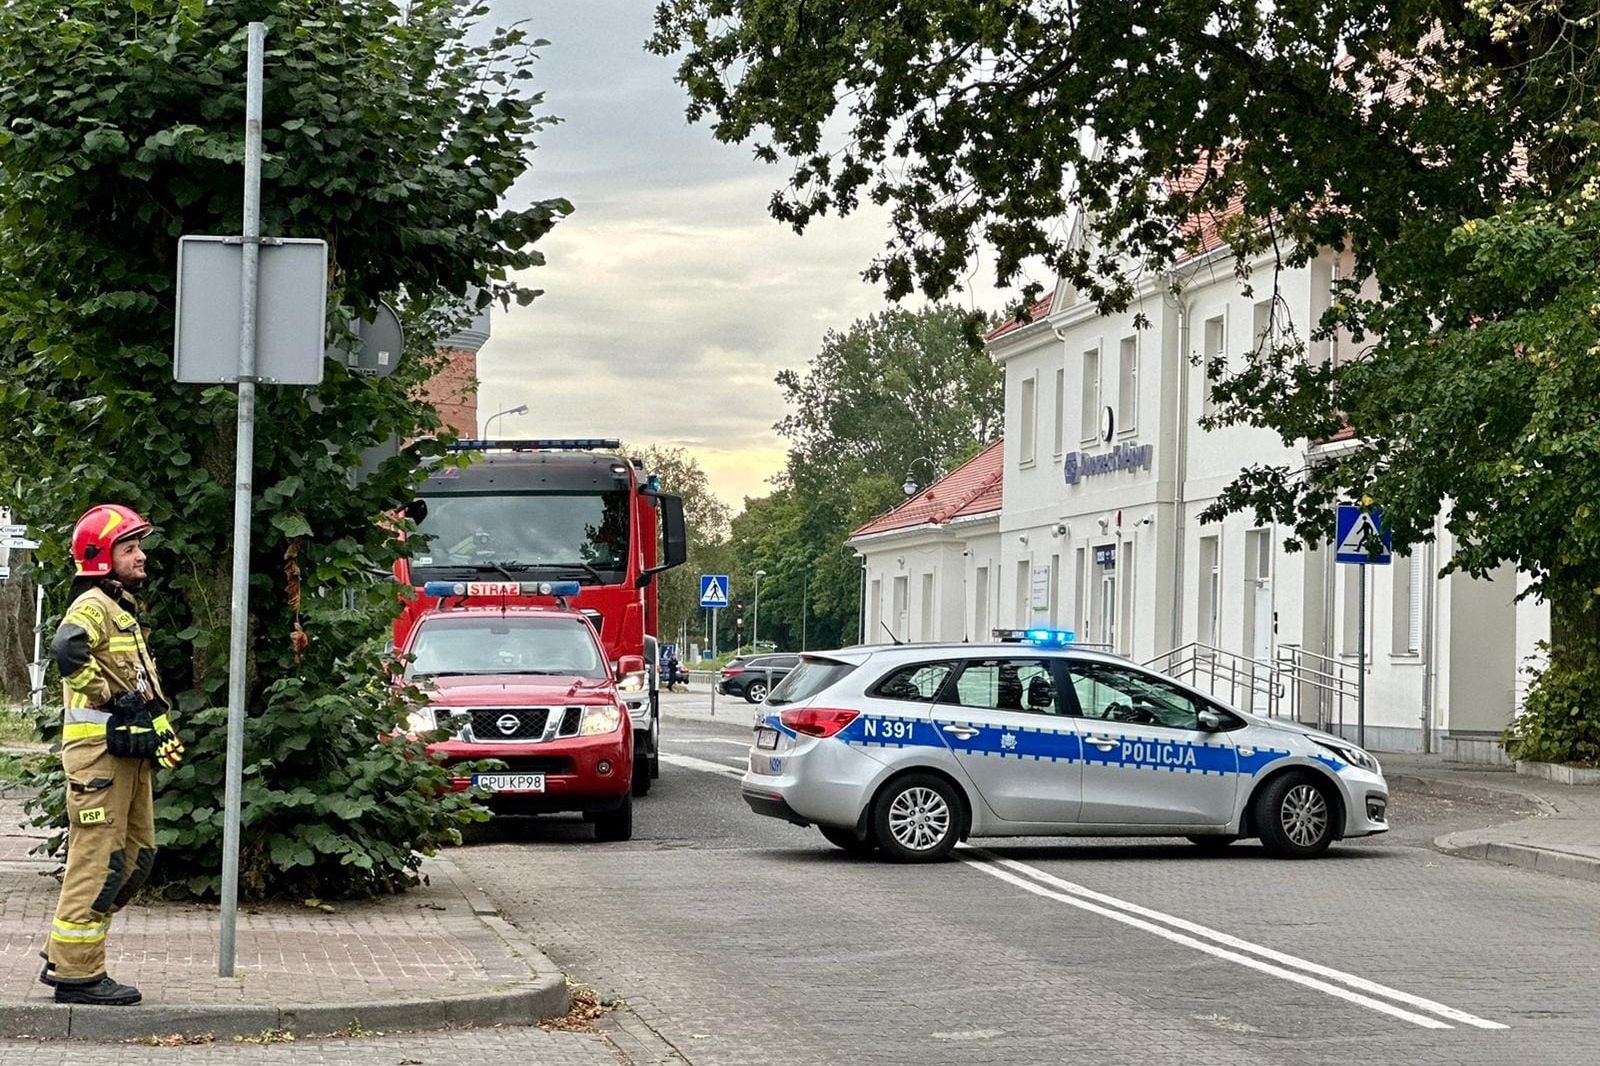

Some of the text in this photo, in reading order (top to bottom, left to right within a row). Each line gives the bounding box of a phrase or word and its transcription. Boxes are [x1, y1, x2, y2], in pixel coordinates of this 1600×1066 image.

[84, 605, 101, 618] PSP
[864, 719, 913, 740] N 391
[1122, 742, 1196, 767] POLICJA
[509, 776, 541, 789] KP98
[82, 811, 101, 821] PSP
